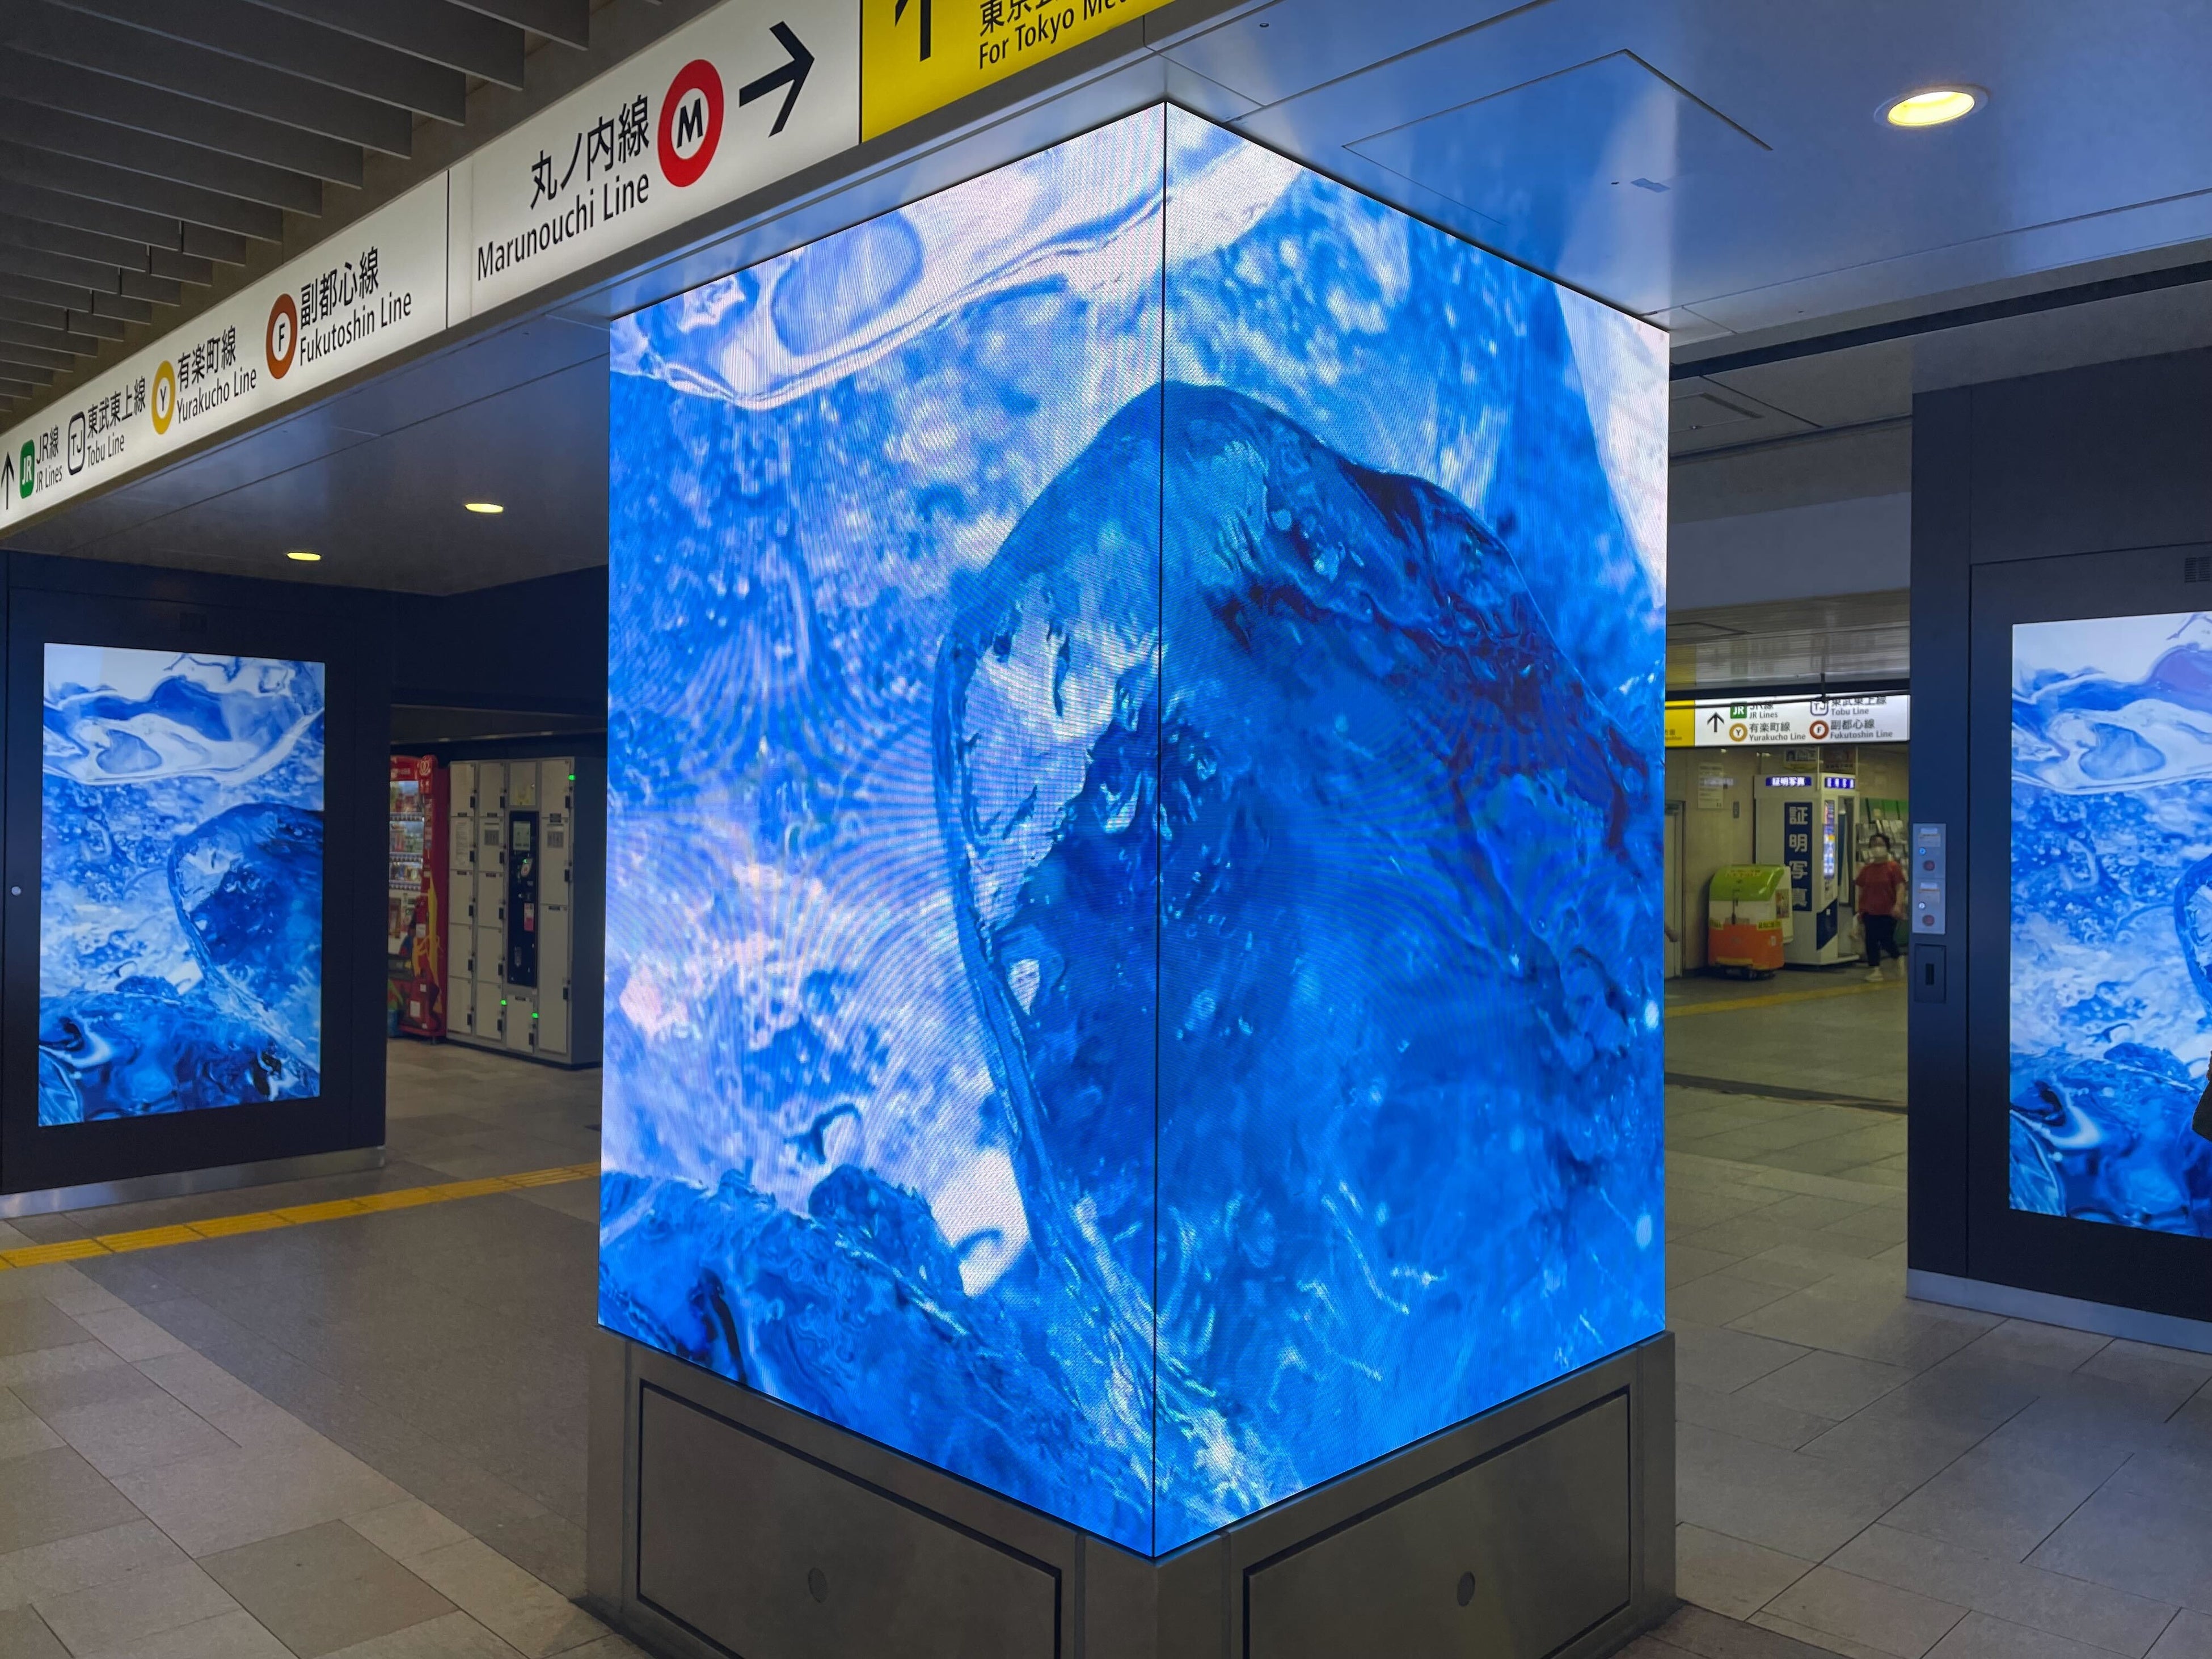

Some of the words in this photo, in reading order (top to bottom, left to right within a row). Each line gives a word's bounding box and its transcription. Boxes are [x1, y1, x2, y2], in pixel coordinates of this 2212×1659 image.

[980, 0, 1058, 37] 東京
[980, 37, 1009, 69] For
[1015, 8, 1074, 51] Tokyo
[676, 98, 703, 149] M
[530, 94, 649, 210] 丸ノ内線
[478, 188, 594, 281] Marunouchi
[603, 173, 649, 221] Line
[301, 246, 379, 330] 副都心線
[278, 323, 285, 352] F
[300, 305, 375, 366] Fukutoshin
[381, 292, 412, 328] Line
[178, 325, 236, 392] 有楽町線
[87, 375, 146, 439] 東武東上線
[160, 386, 167, 411] Y
[177, 378, 230, 424] Yurakucho
[234, 366, 257, 398] Line
[36, 425, 59, 465] JR線
[71, 430, 83, 456] TJ
[87, 440, 105, 467] Tobu
[108, 432, 125, 458] Line
[22, 455, 32, 486] JR
[36, 470, 43, 493] JR
[45, 464, 63, 488] Lines
[1733, 705, 1745, 715] JR
[1749, 722, 1791, 733] 有楽町線
[1830, 719, 1875, 730] 副都心線
[1789, 807, 1808, 906] 証明写真
